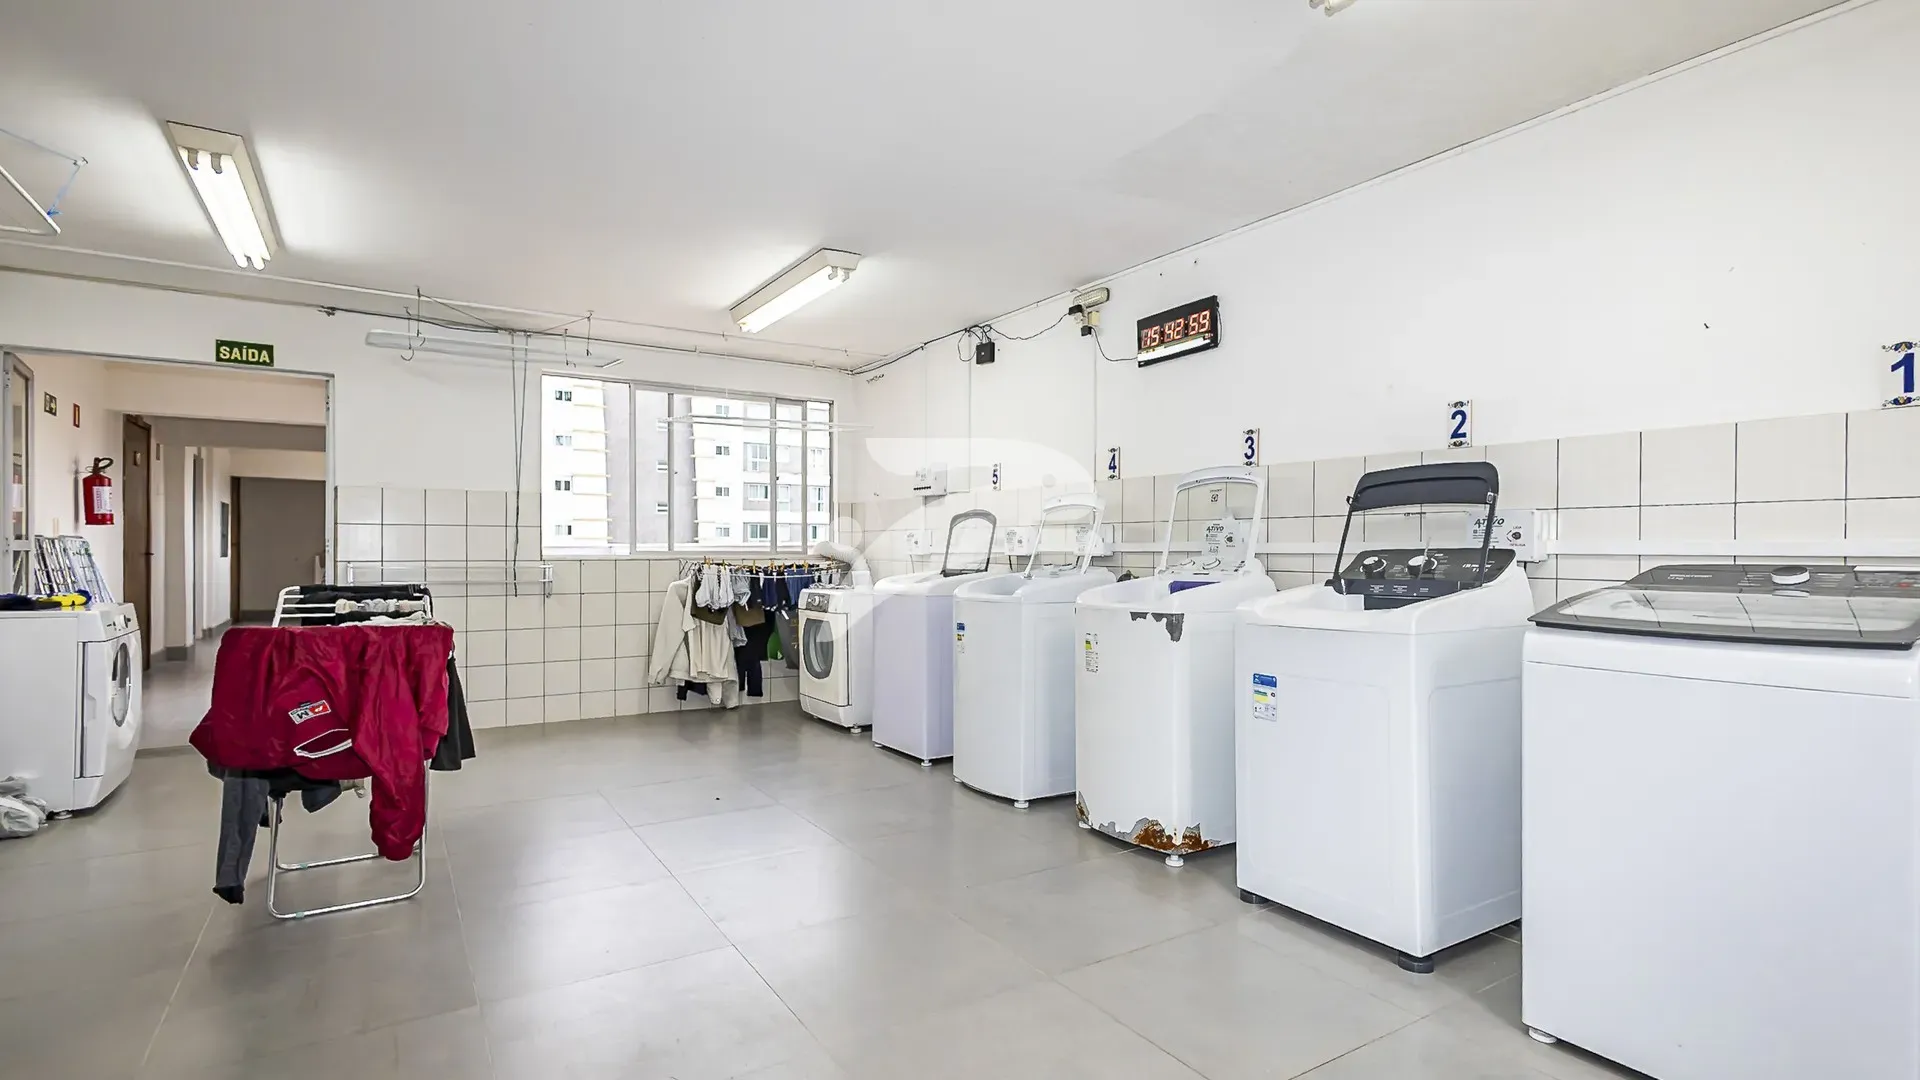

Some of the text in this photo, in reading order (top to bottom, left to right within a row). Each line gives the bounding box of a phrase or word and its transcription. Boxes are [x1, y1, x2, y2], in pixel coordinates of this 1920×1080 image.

[1142, 309, 1211, 349] 15:42:59
[218, 345, 271, 363] SAÍDA
[1890, 352, 1915, 393] 1
[1450, 409, 1467, 440] 2
[1244, 435, 1255, 460] 3
[1108, 453, 1117, 473] 4
[992, 468, 999, 485] 5
